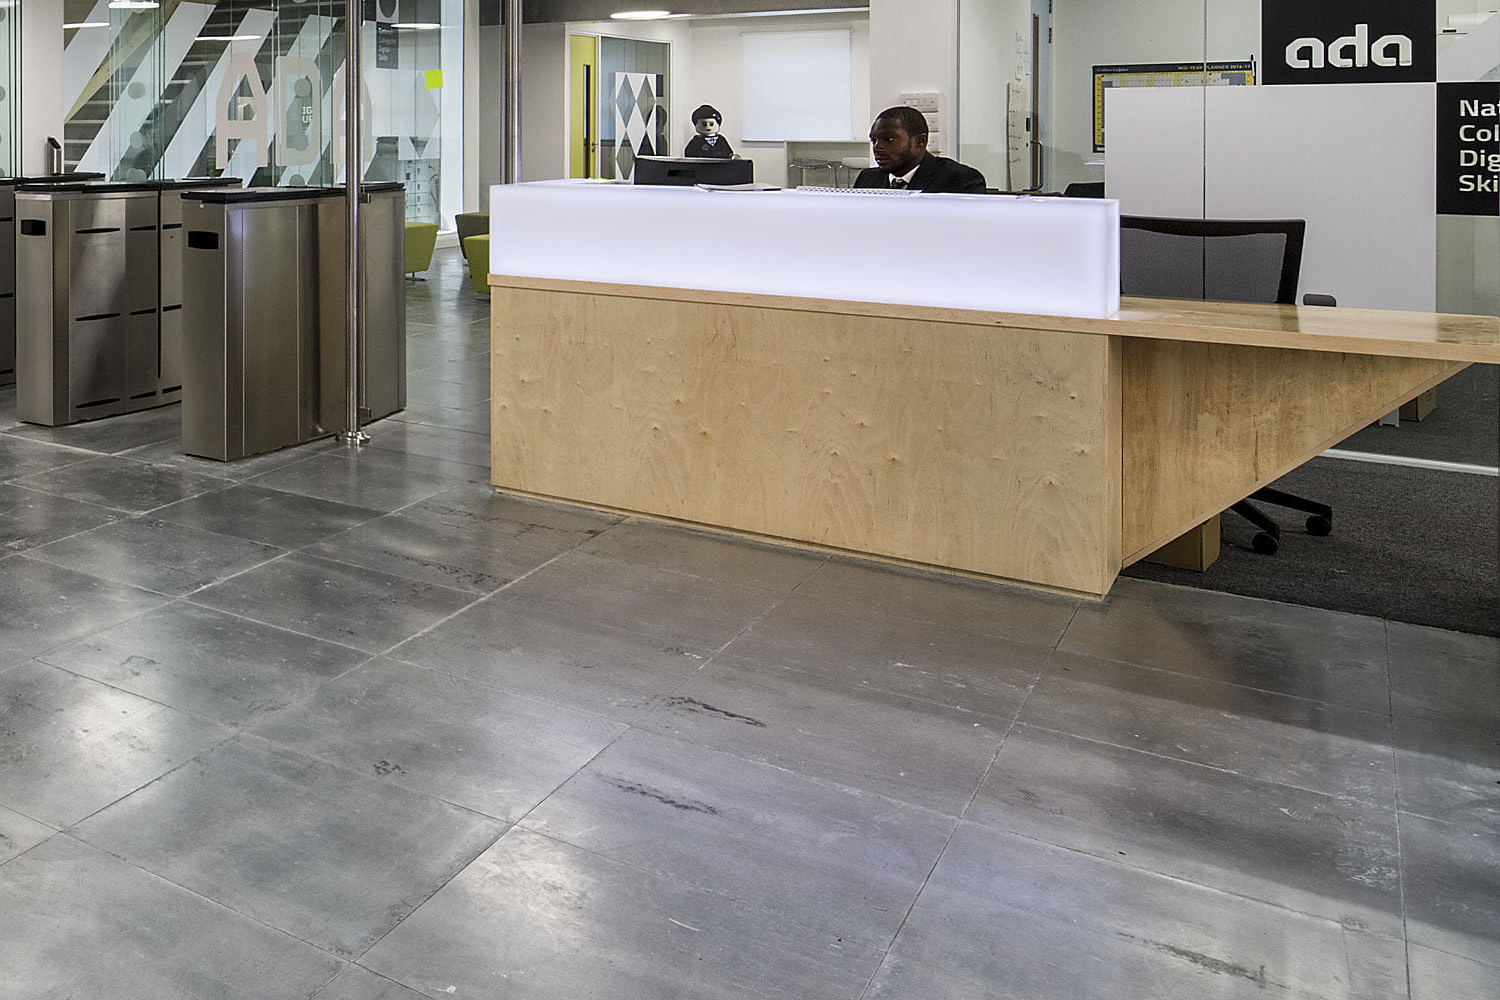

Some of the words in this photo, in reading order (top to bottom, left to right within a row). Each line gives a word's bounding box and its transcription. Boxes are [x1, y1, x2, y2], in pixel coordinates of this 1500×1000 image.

[1285, 23, 1413, 69] ada
[1459, 124, 1500, 142] Col
[1459, 150, 1500, 172] Dig
[1459, 175, 1499, 193] Ski
